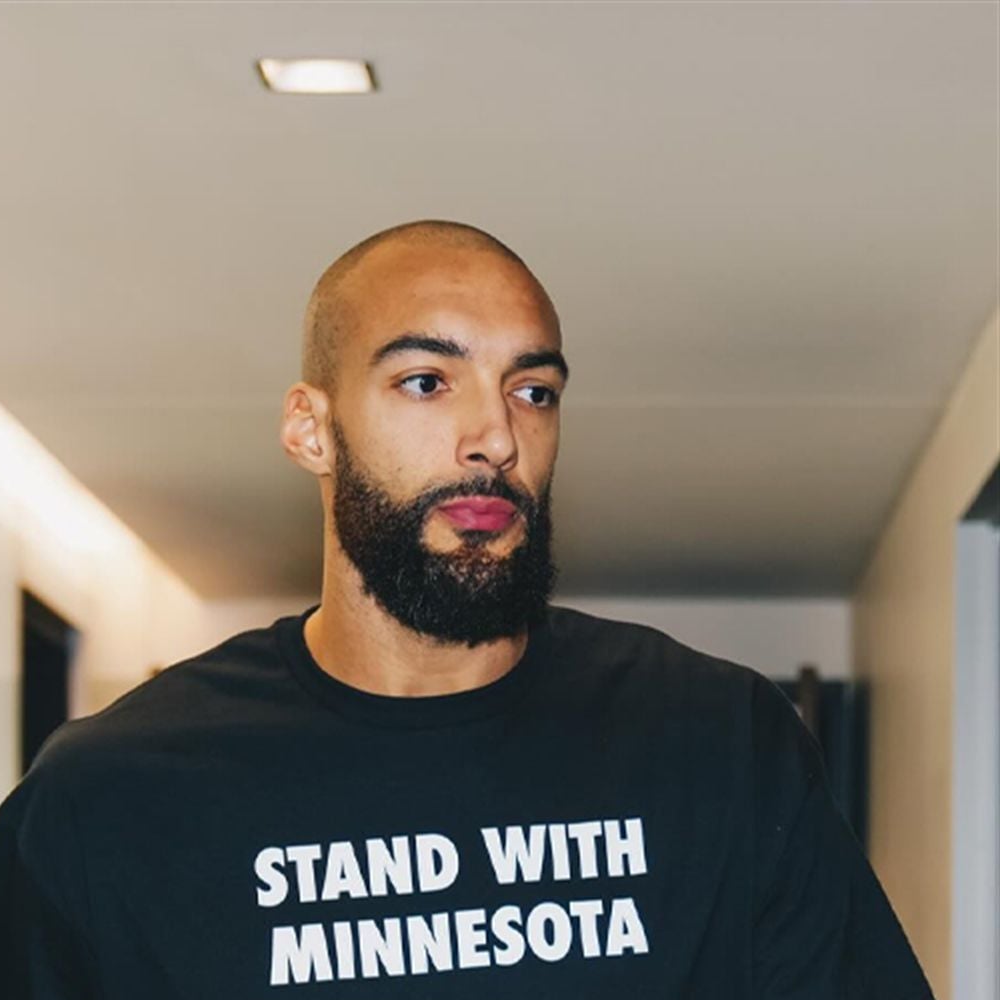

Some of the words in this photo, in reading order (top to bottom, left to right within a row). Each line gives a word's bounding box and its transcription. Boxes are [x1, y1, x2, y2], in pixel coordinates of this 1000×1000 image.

[254, 833, 459, 907] STAND
[480, 817, 647, 885] WITH
[270, 897, 649, 986] MINNESOTA
